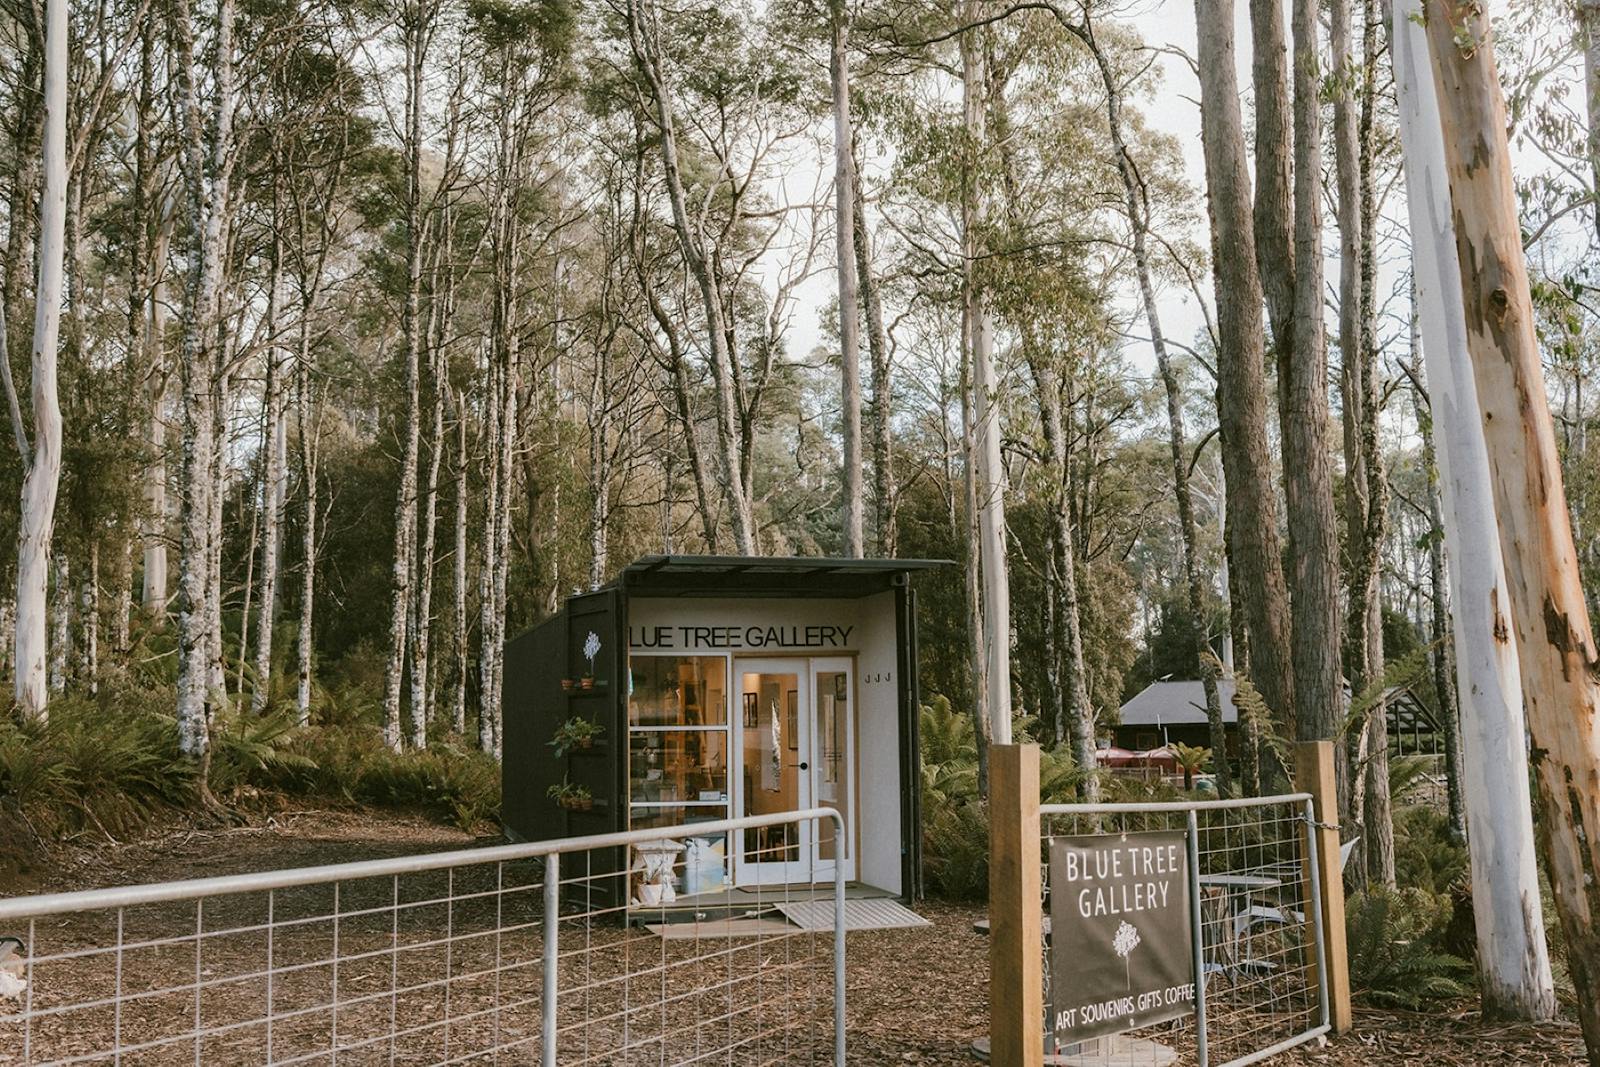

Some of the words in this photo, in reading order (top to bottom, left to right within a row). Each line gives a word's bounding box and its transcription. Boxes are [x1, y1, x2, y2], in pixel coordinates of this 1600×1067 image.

[629, 626, 674, 648] LUE
[678, 626, 742, 649] TREE
[745, 626, 855, 648] GALLERY
[1066, 849, 1122, 882] BLUE
[1128, 845, 1178, 876] TREE
[1078, 881, 1169, 919] GALLERY
[1055, 1008, 1077, 1031] ART
[1080, 996, 1135, 1024] SOUVENIRS
[1137, 990, 1162, 1012] GIFTS
[1165, 983, 1196, 1005] COFFEE
